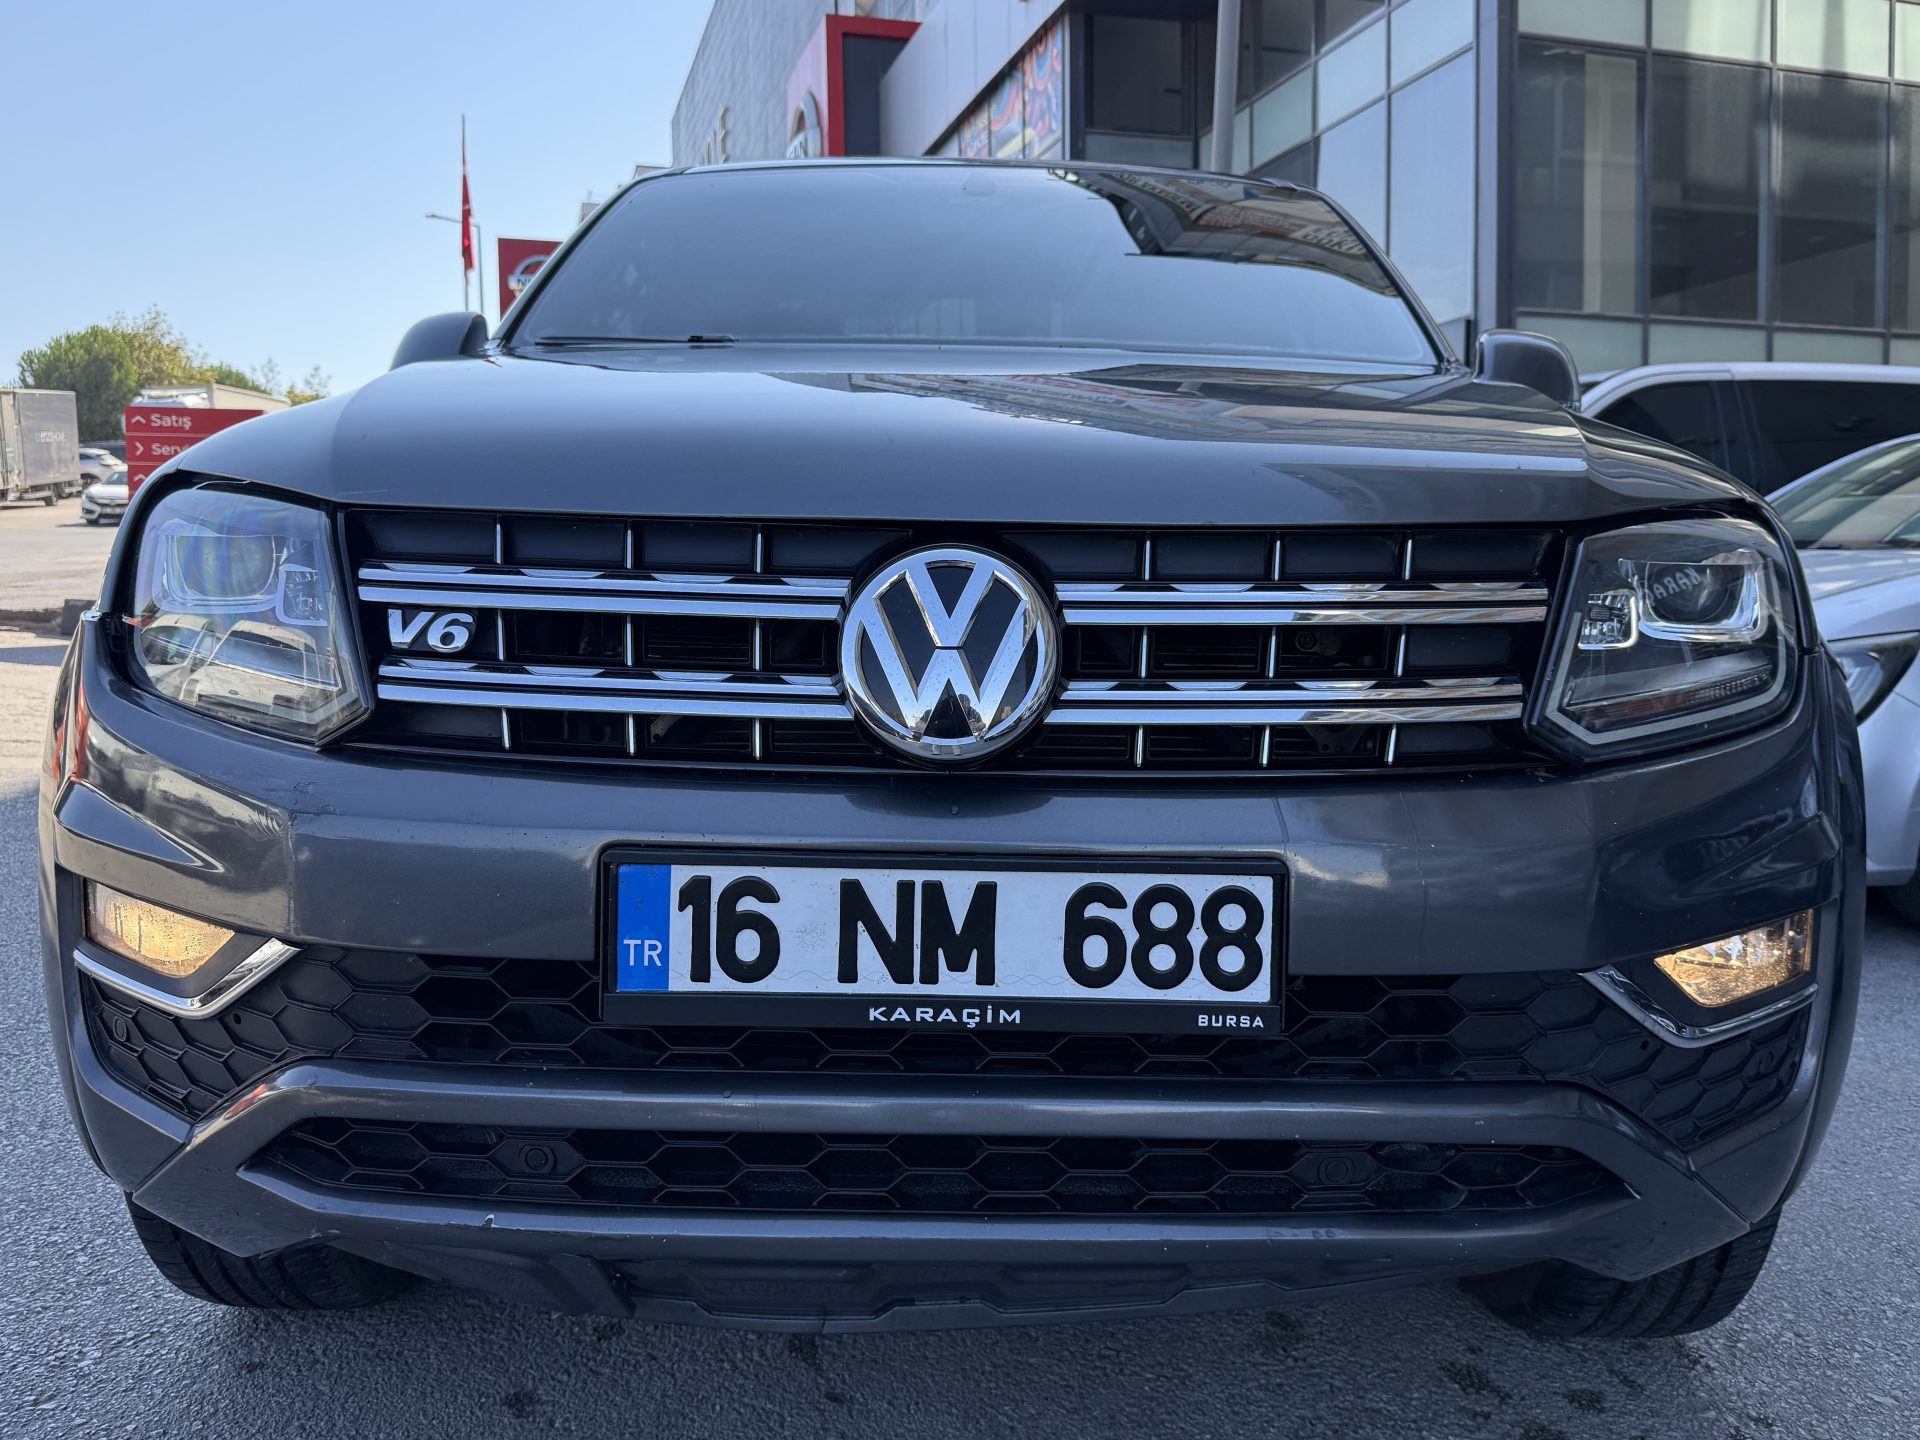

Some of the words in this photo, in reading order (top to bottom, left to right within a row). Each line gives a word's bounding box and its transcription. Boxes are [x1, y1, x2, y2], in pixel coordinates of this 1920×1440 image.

[150, 413, 192, 430] Satış
[387, 608, 474, 653] V6
[678, 875, 781, 984] 16
[837, 878, 998, 986] NM
[1063, 881, 1265, 993] 688
[623, 939, 663, 967] TR
[868, 1005, 1022, 1029] KARAÇİM
[1197, 1014, 1265, 1029] BURSA
